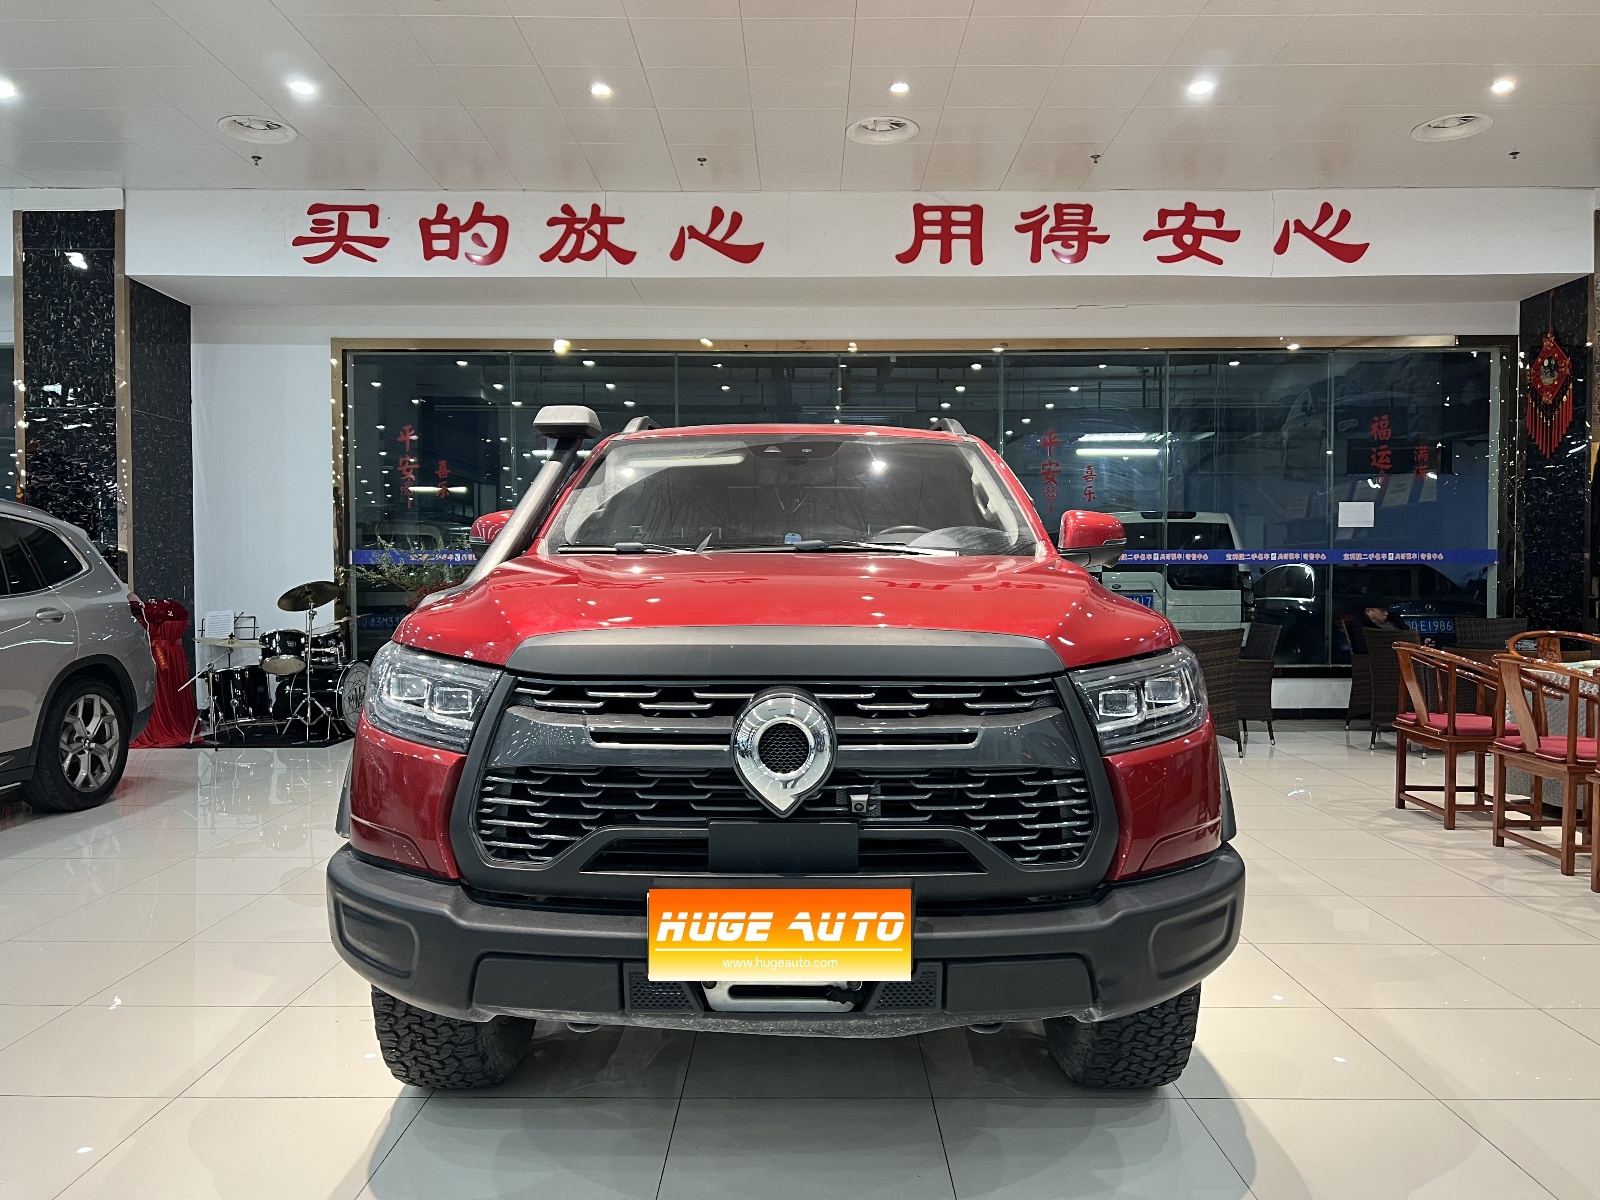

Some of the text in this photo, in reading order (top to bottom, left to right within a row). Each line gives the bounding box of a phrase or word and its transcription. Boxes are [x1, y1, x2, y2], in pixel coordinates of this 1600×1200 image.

[292, 202, 1370, 266] 买的放心 用得安心
[397, 424, 420, 481] 平安
[1040, 428, 1062, 486] 平安
[1371, 414, 1392, 469] 福运
[435, 460, 451, 498] 喜乐
[1082, 465, 1097, 503] 喜乐
